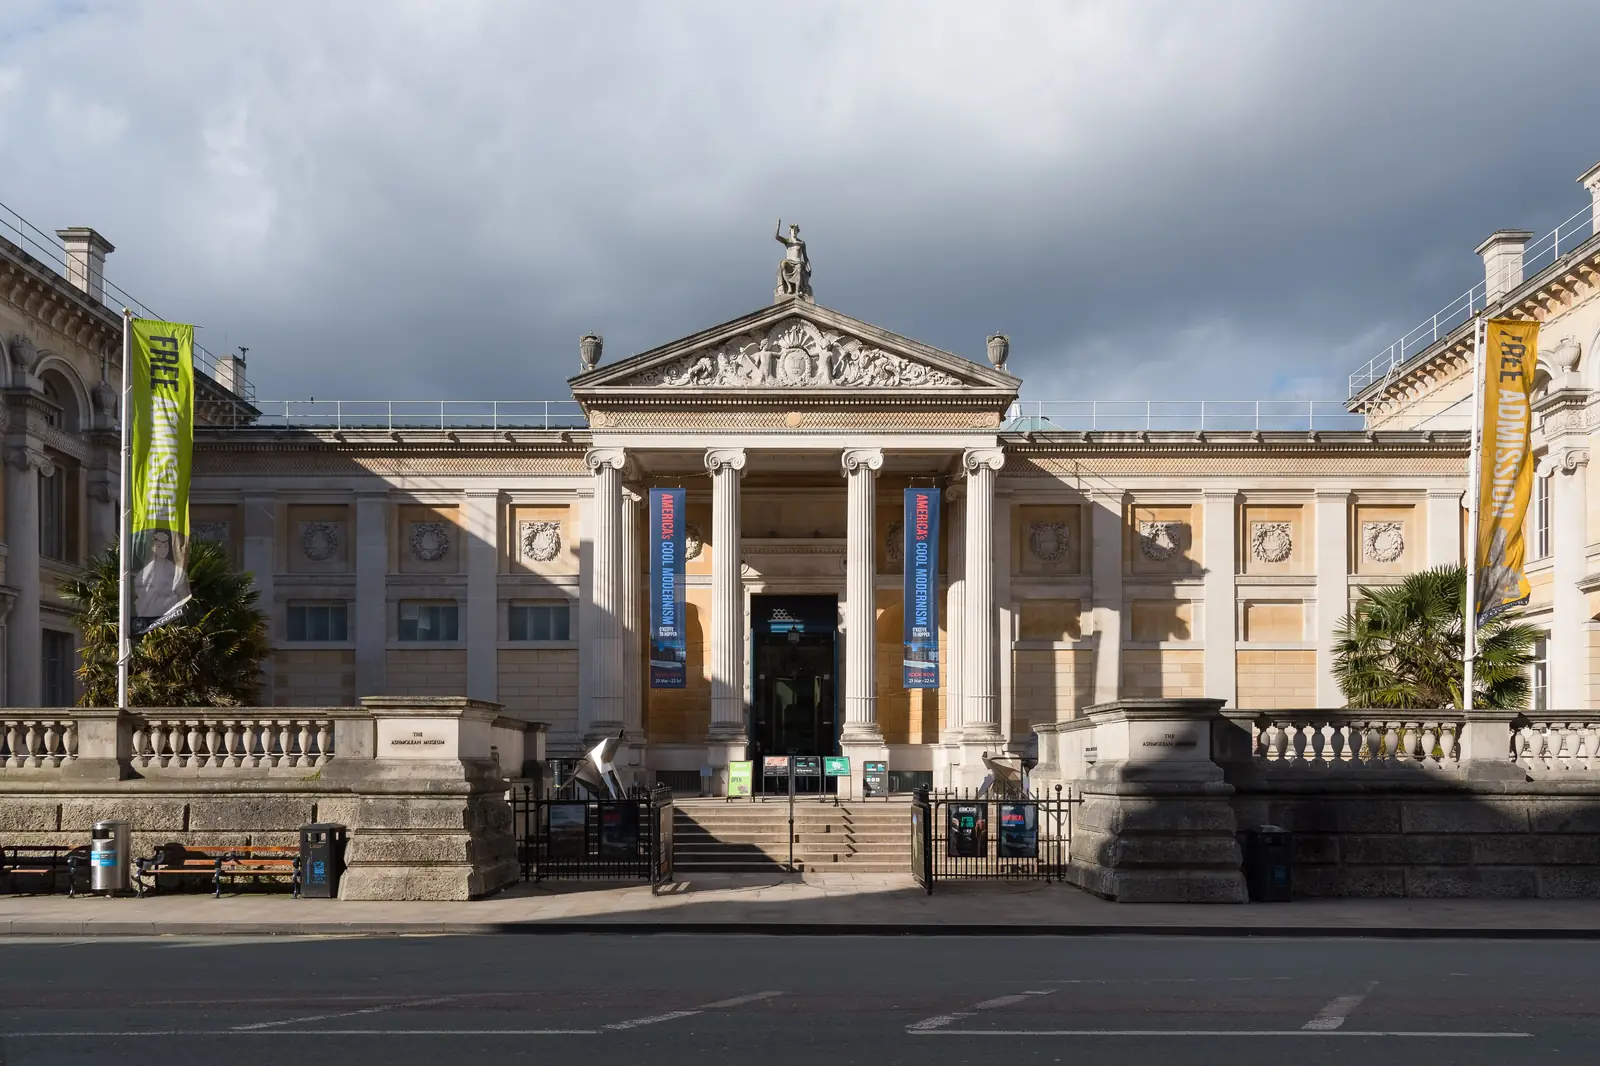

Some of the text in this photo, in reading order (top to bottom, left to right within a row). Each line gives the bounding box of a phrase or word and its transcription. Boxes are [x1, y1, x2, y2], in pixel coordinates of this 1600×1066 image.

[147, 335, 179, 522] FREE ADMISSION
[1492, 329, 1527, 519] FREE ADMISSION
[662, 541, 674, 566] COOL
[916, 542, 928, 567] COOL
[662, 568, 674, 625] MODERNISM
[916, 568, 928, 625] MODERNISM
